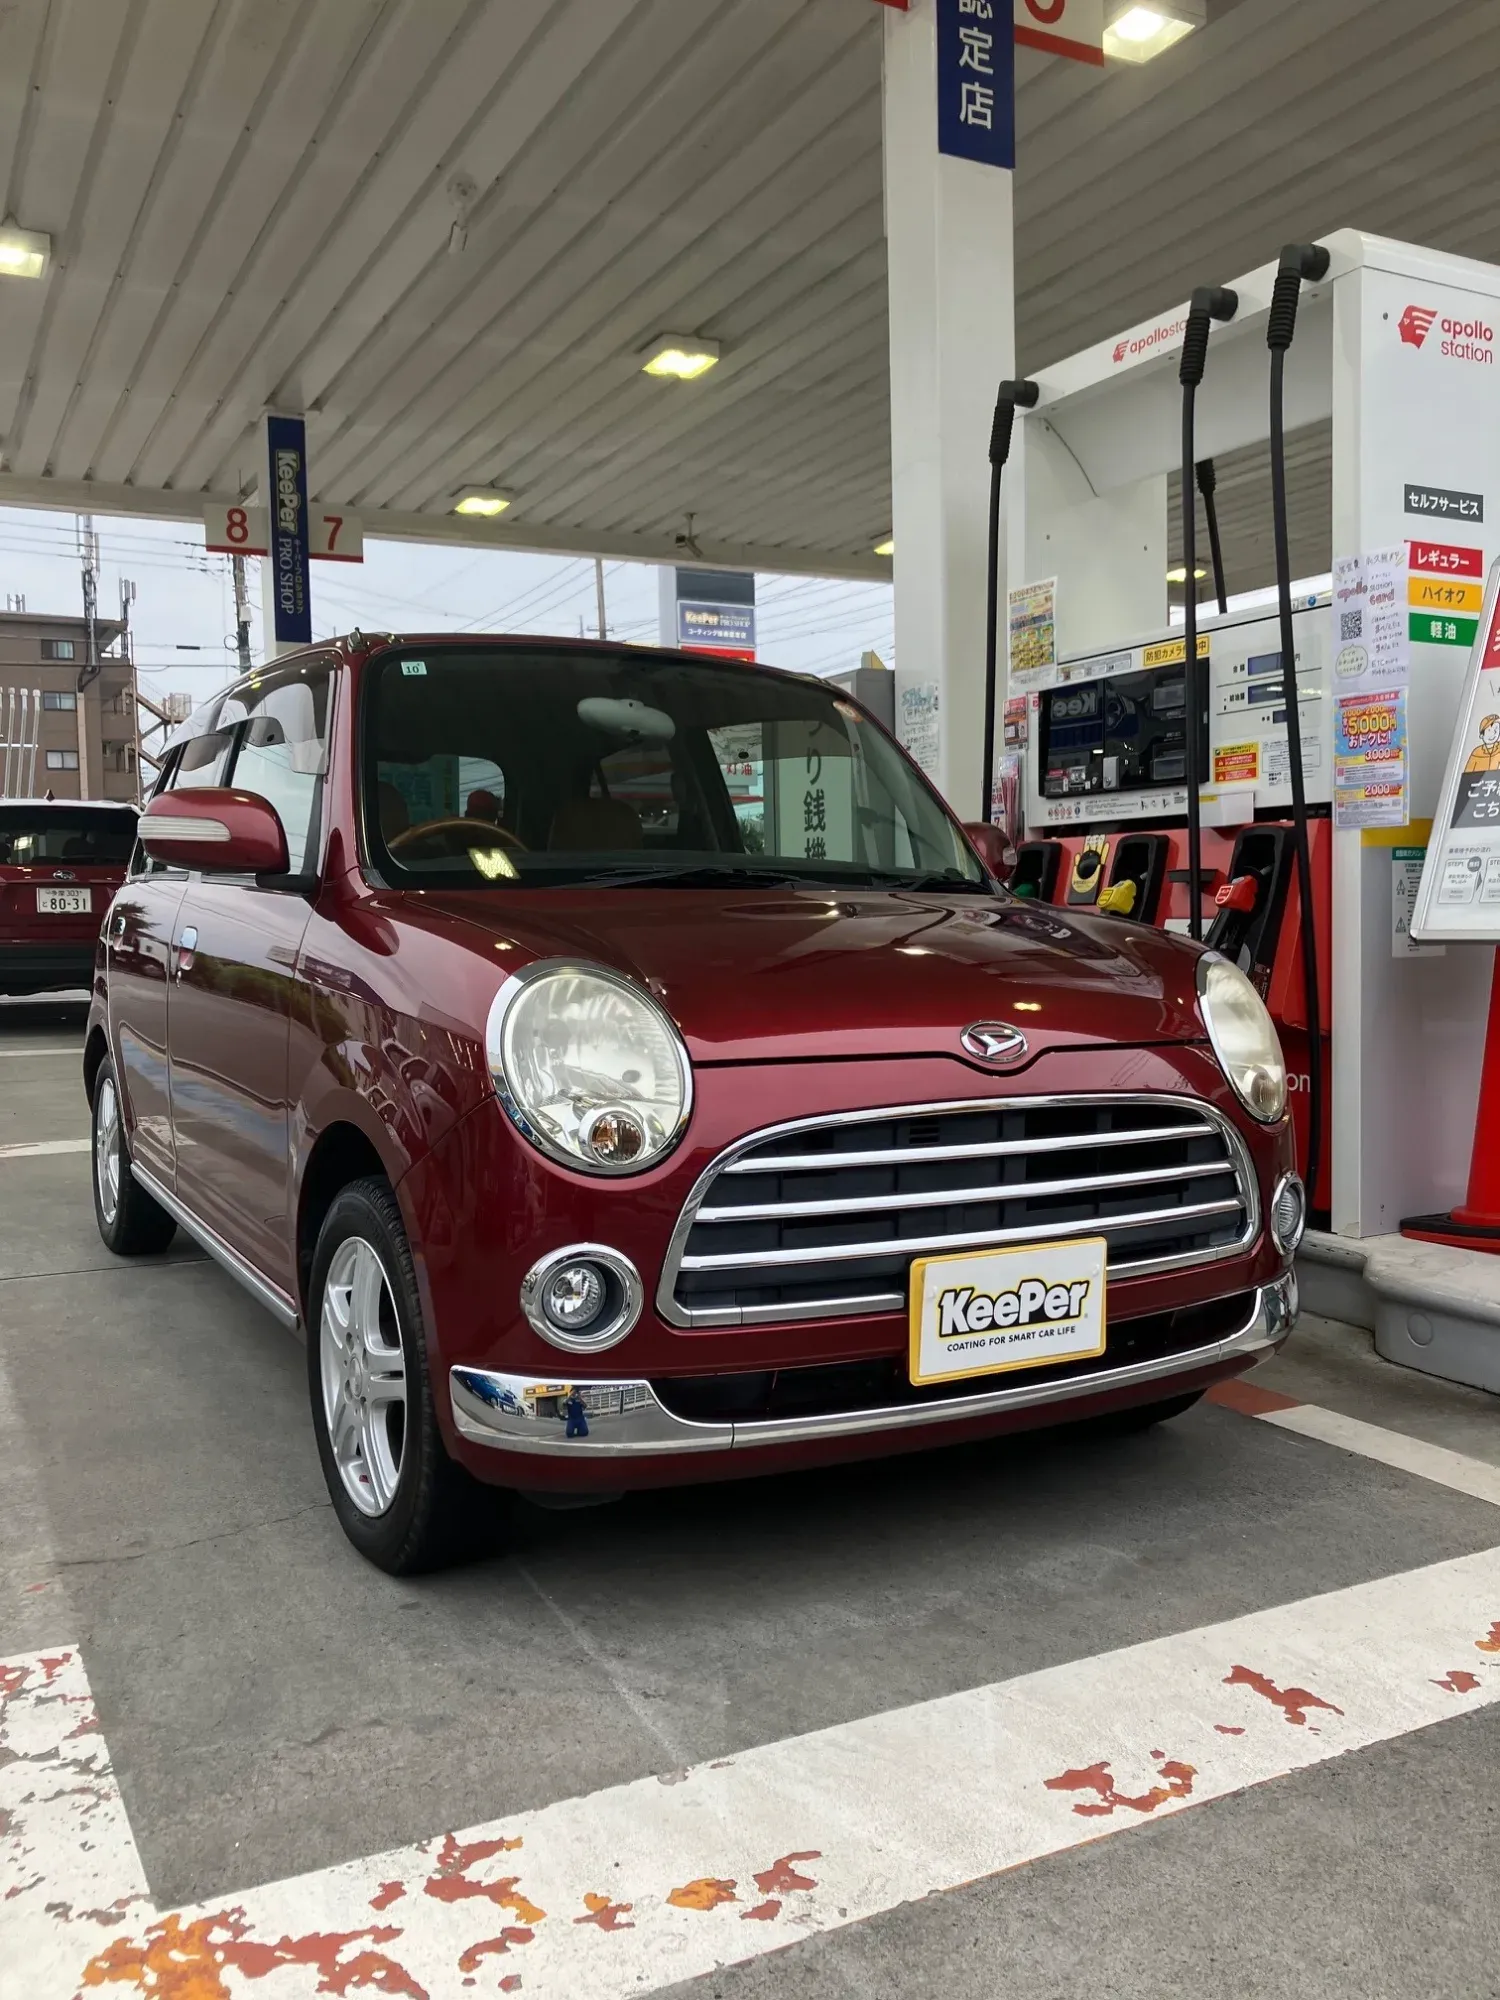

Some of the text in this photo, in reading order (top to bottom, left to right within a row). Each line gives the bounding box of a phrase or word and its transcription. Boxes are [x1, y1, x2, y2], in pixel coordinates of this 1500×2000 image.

[1441, 318, 1493, 342] apollo
[1441, 340, 1493, 364] station
[1409, 492, 1479, 516] セルフサービス
[226, 508, 248, 543] 8
[275, 450, 299, 614] KeePer PRO SHOP
[323, 515, 343, 551] 7
[1417, 549, 1469, 569] レギュラー
[1337, 579, 1368, 603] apollo
[1422, 586, 1465, 604] ハイオク
[1430, 620, 1457, 640] 軽油
[1145, 641, 1207, 663] 防犯カメラ中
[726, 763, 753, 776] 灯油
[1468, 779, 1500, 798] ご予
[1473, 801, 1500, 818] こち
[50, 898, 86, 910] 80-31
[938, 1278, 1090, 1338] KeePer
[947, 1325, 1076, 1352] COATING FOR SMART CAR LIFE
